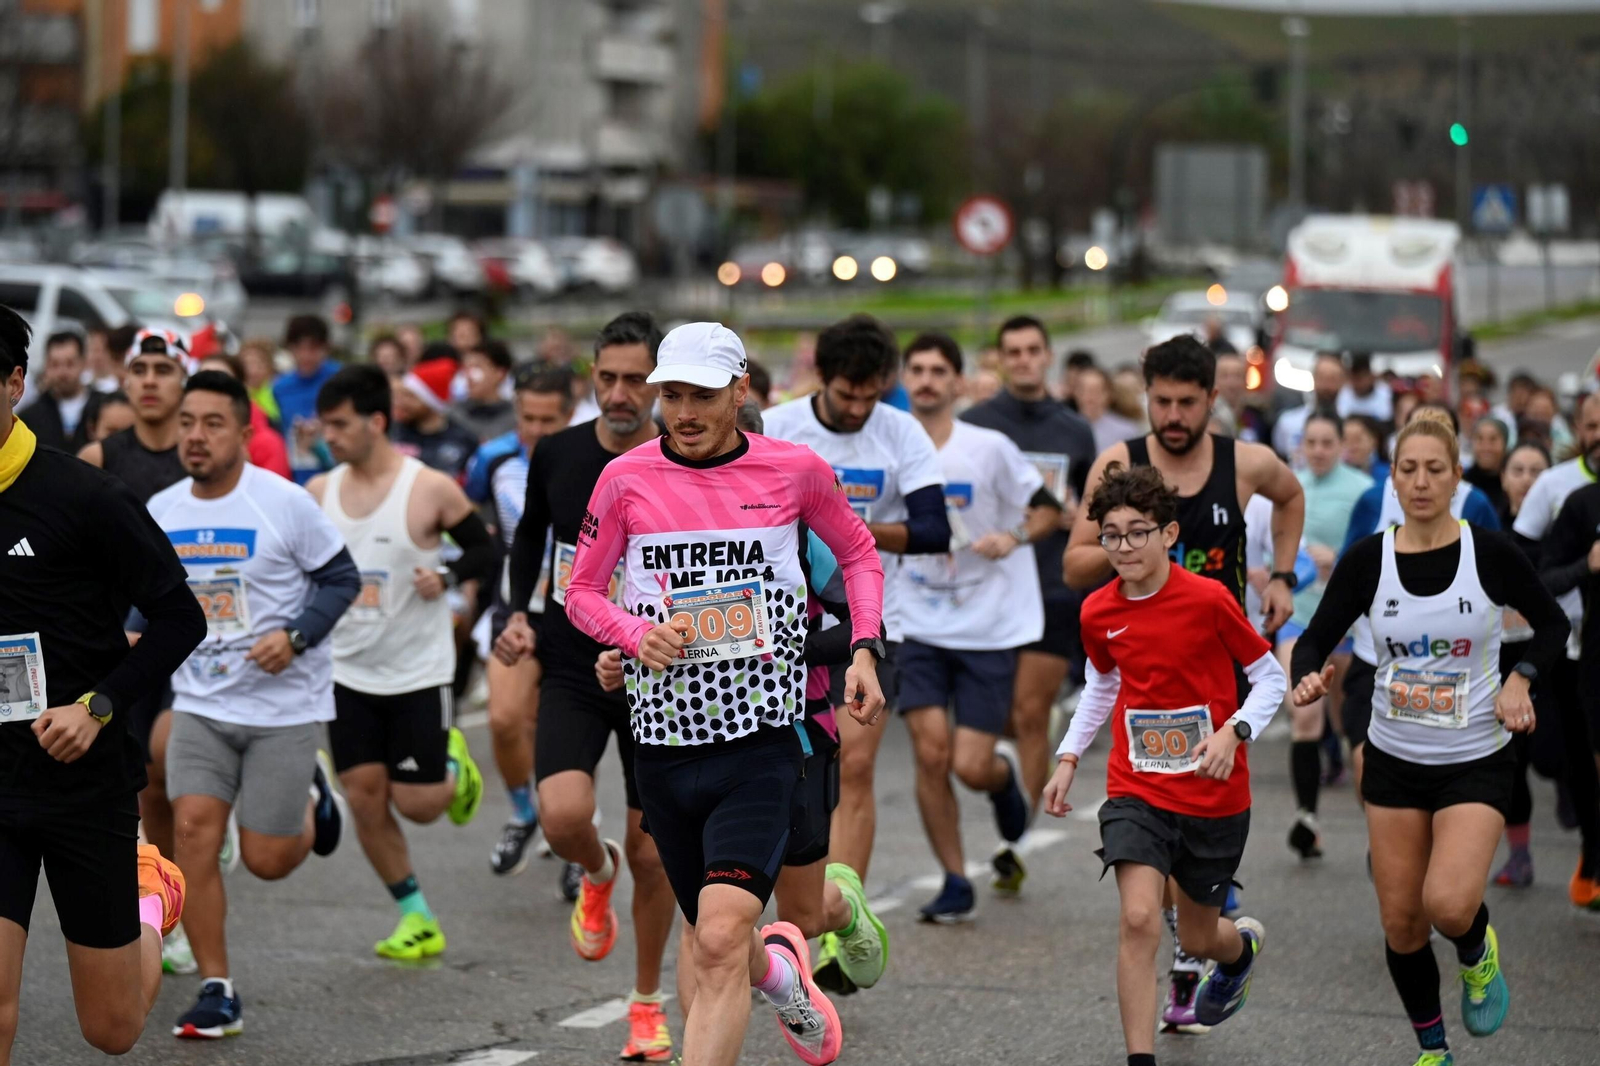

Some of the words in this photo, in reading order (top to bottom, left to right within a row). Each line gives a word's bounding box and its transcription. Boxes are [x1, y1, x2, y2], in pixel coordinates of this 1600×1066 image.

[642, 540, 764, 569] ENTRENA
[1168, 542, 1224, 572] dea
[673, 588, 756, 604] CORDOBARA
[679, 647, 719, 660] LERNA
[1385, 634, 1472, 658] indea
[1142, 729, 1188, 758] 90
